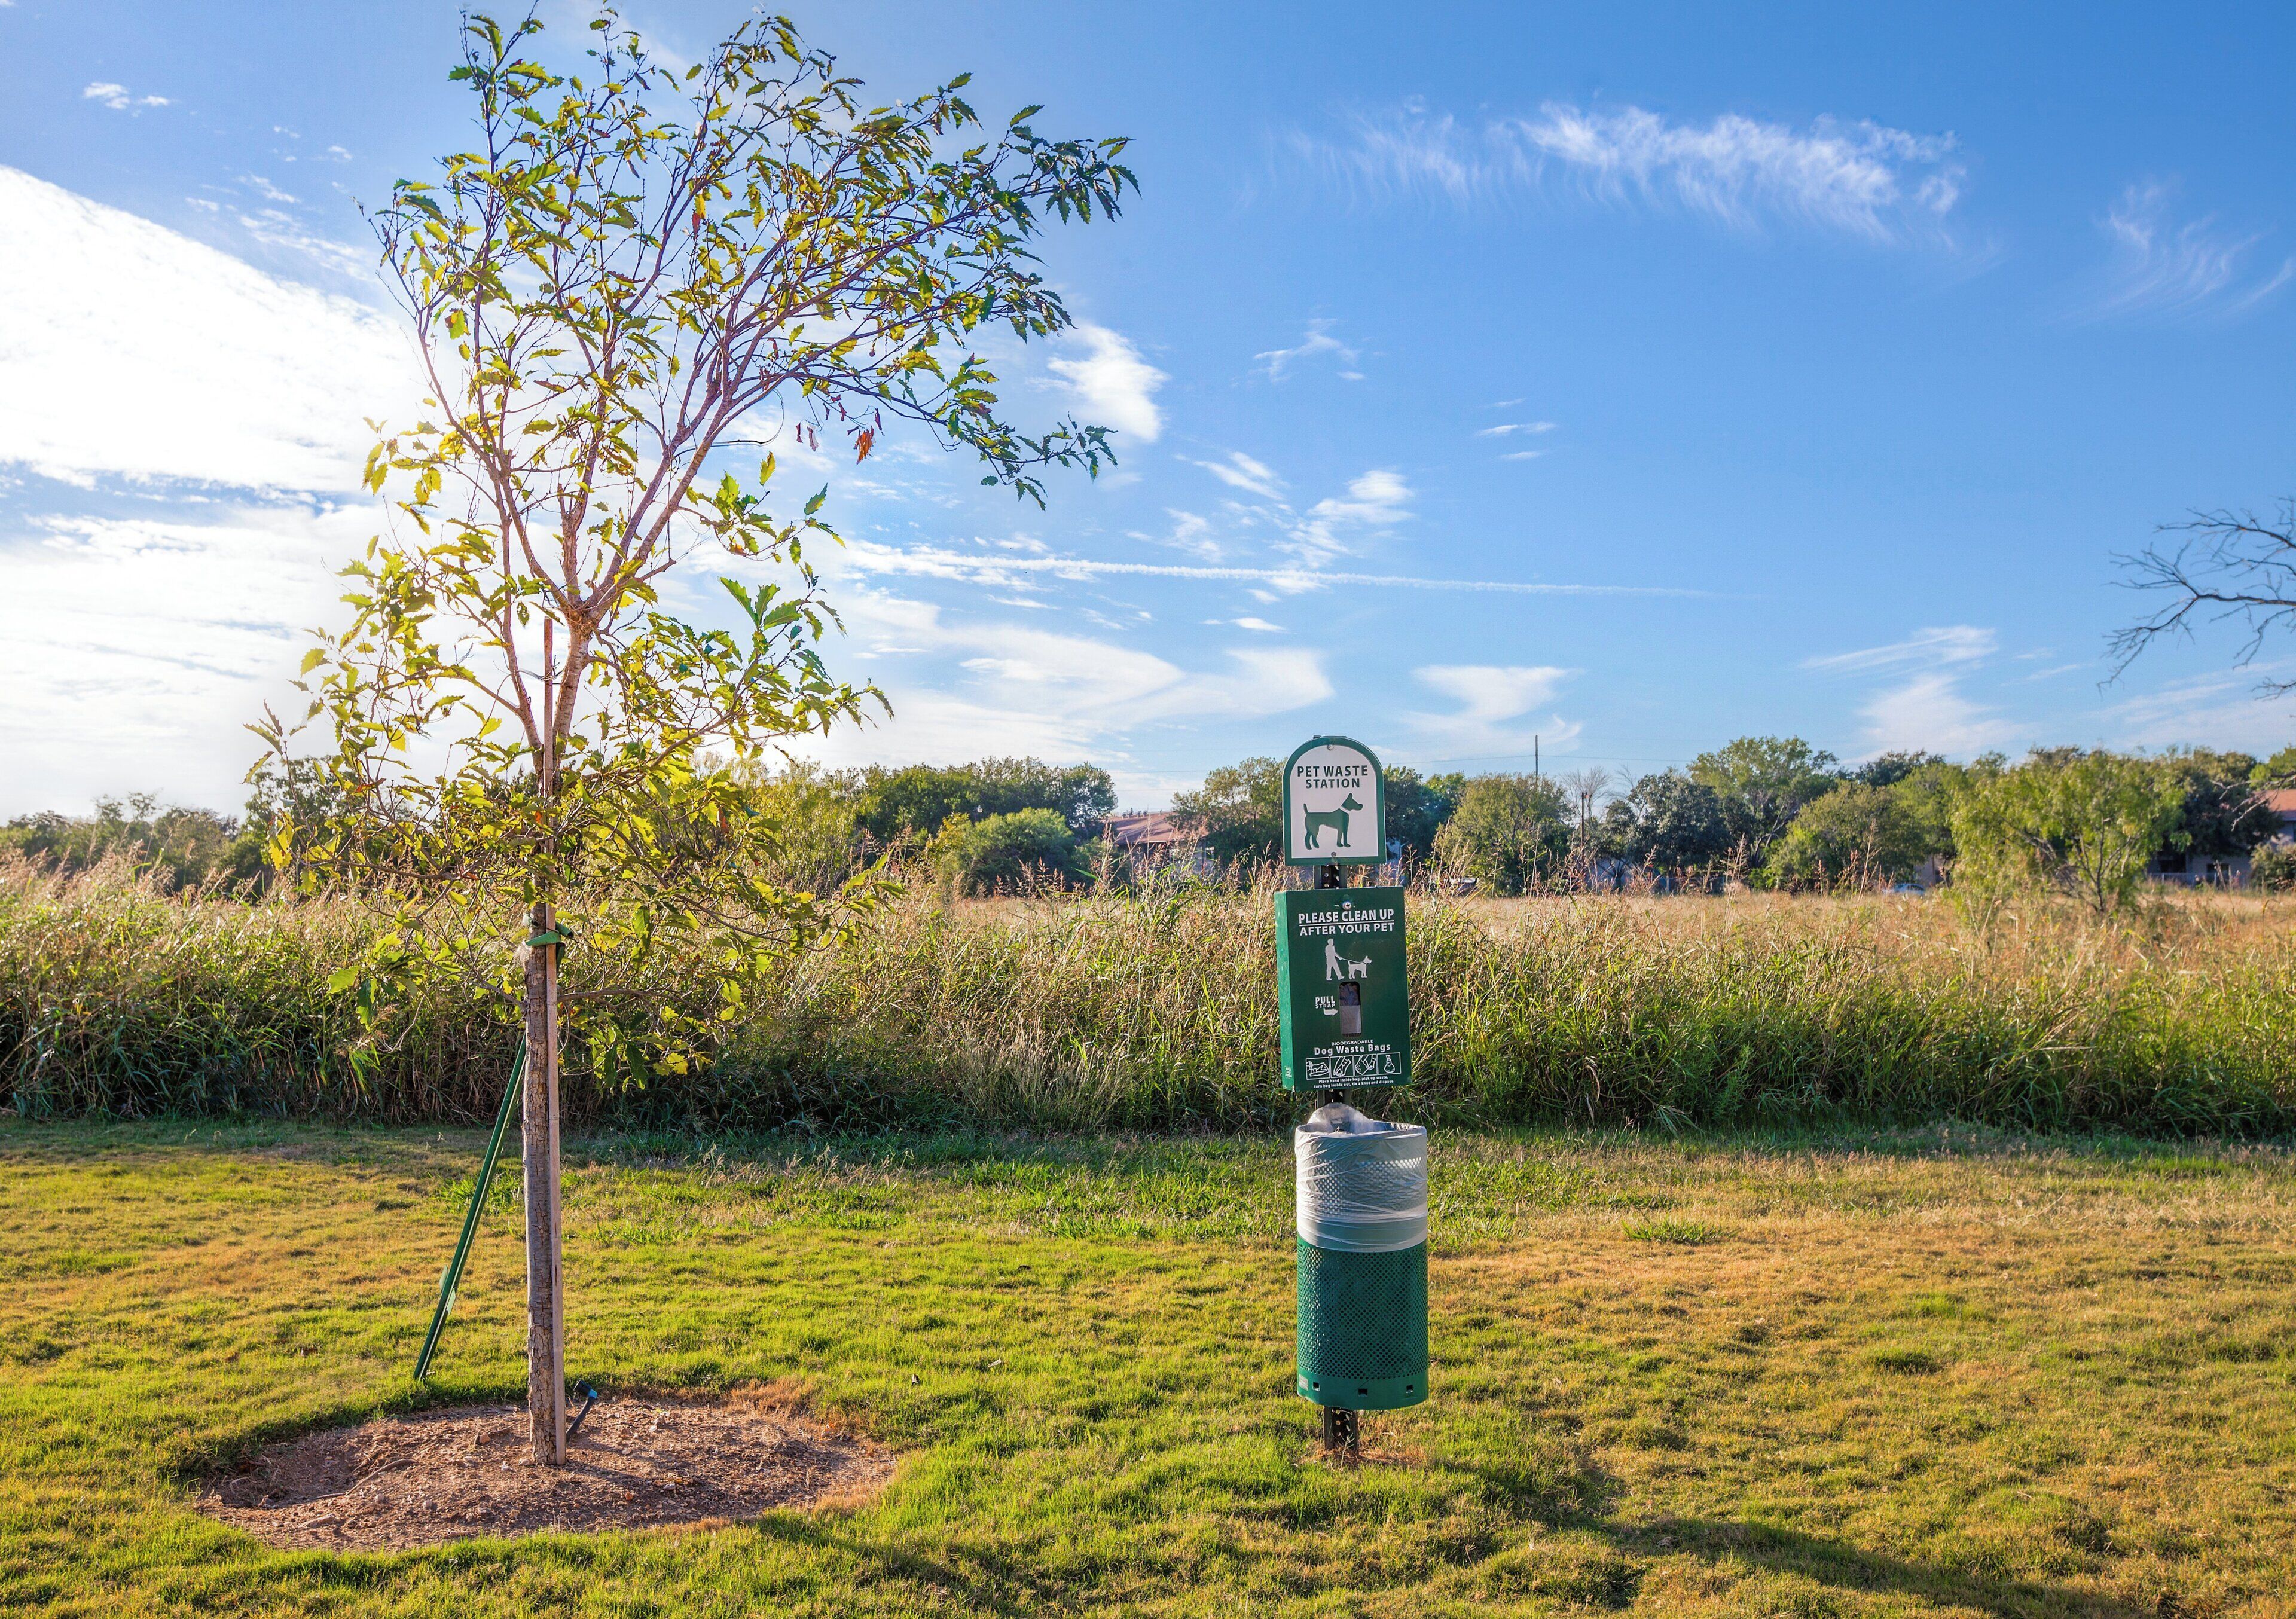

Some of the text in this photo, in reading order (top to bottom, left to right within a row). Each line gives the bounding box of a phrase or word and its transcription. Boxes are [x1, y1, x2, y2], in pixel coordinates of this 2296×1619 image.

[1297, 765, 1367, 777] PET WASTE
[1306, 778, 1360, 789] STATION
[1298, 909, 1394, 924] PLEASE CLEAN UP
[1299, 922, 1394, 936] AFTER YOUR PET
[1314, 1044, 1391, 1056] Dog Waste Bags
